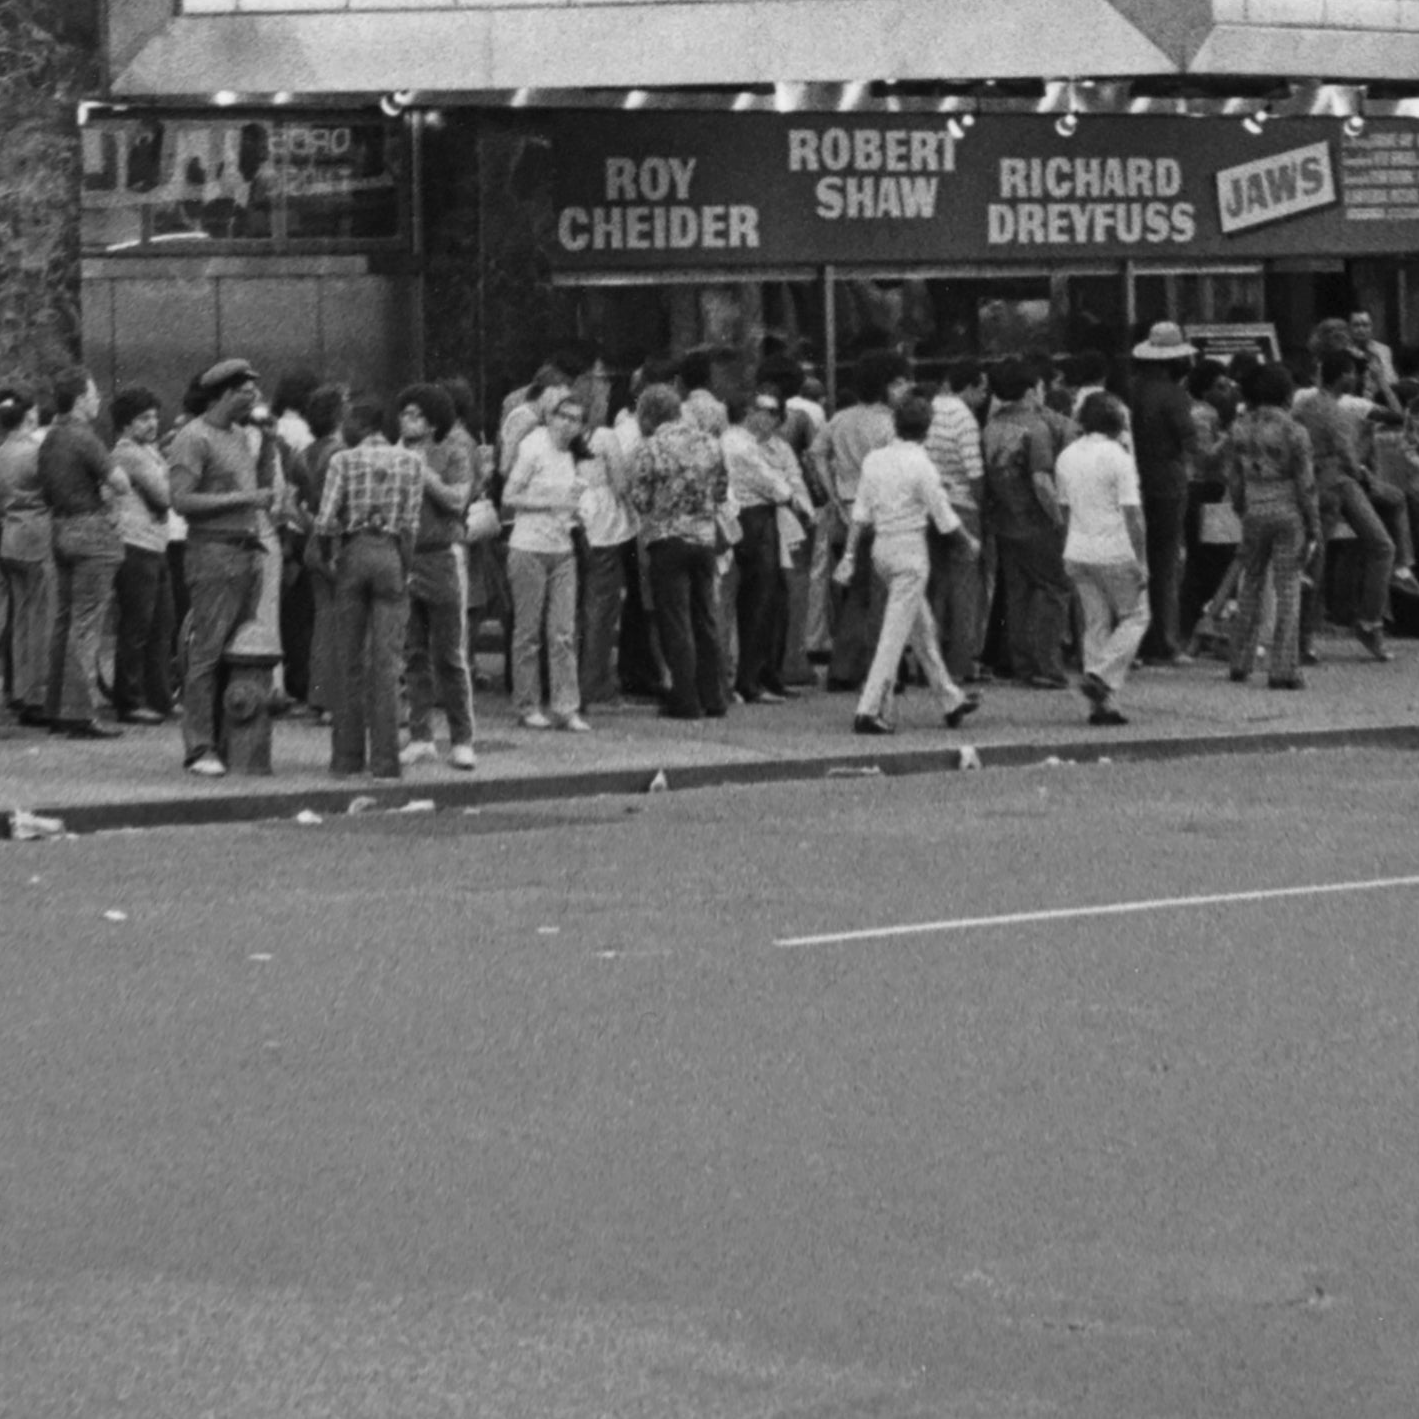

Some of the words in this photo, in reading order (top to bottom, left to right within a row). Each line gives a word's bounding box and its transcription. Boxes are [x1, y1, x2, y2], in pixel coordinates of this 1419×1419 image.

[788, 129, 957, 172] ROBERT
[604, 156, 697, 200] ROY
[815, 176, 939, 220] SHAW
[999, 157, 1182, 198] RICHARD
[1226, 156, 1324, 218] JAWS
[557, 204, 761, 252] CHEIDER
[987, 202, 1197, 245] DREYFUSS
